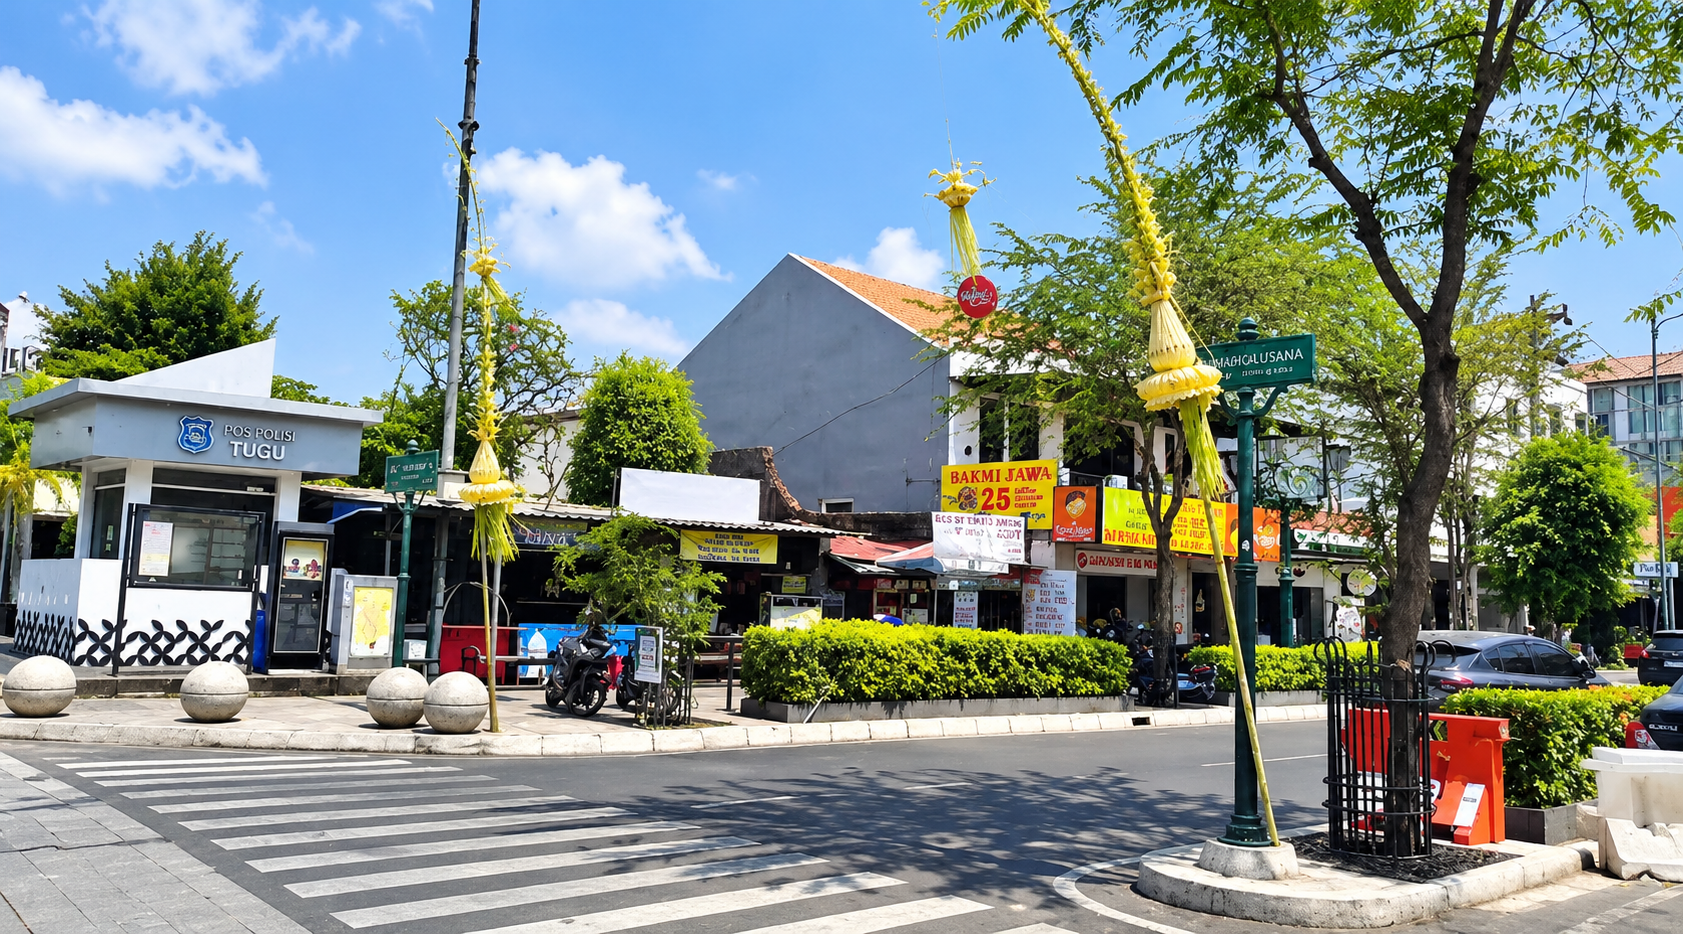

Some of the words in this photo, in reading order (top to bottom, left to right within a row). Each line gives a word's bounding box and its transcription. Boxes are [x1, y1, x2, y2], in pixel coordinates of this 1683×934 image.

[224, 424, 251, 438] POS
[255, 427, 296, 442] POLISI
[229, 441, 286, 461] TUGU
[950, 468, 1001, 485] BAKMI
[1005, 466, 1052, 482] JAWA
[981, 487, 1011, 511] 25
